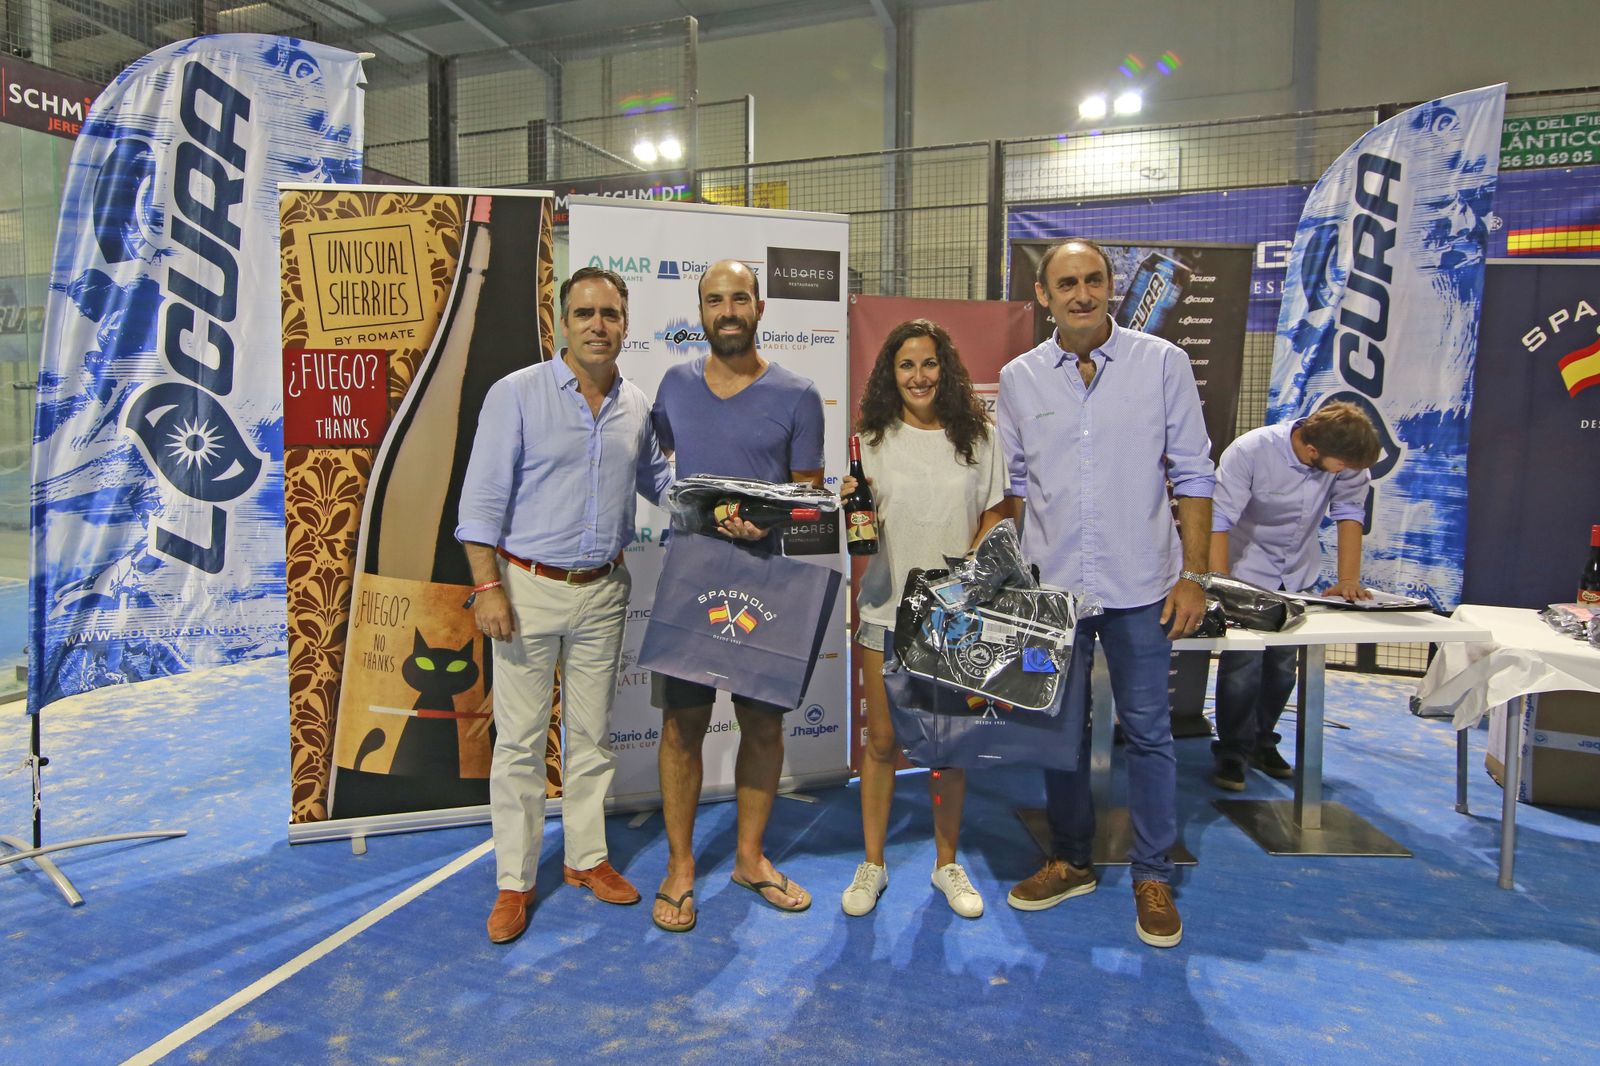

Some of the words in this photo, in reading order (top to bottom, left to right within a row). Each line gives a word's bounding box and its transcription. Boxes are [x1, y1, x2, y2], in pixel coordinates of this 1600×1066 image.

[1536, 118, 1571, 131] DEL
[1525, 154, 1546, 166] 30
[1571, 150, 1593, 163] 05
[327, 240, 408, 275] UNUSUAL
[773, 267, 834, 280] ALBORES
[327, 281, 409, 316] SHERRIES
[334, 335, 351, 346] BY
[358, 328, 415, 343] ROMATE
[763, 331, 794, 343] Diario
[796, 331, 809, 343] de
[811, 333, 835, 346] Jerez
[288, 353, 379, 398] ¿FUEGO?
[332, 395, 351, 417] NO
[315, 417, 369, 440] THANKS
[353, 590, 410, 629] ¿FUEGO?
[373, 633, 387, 652] NO
[363, 651, 397, 674] THANKS
[645, 728, 659, 740] de
[790, 724, 839, 738] Jhayber
